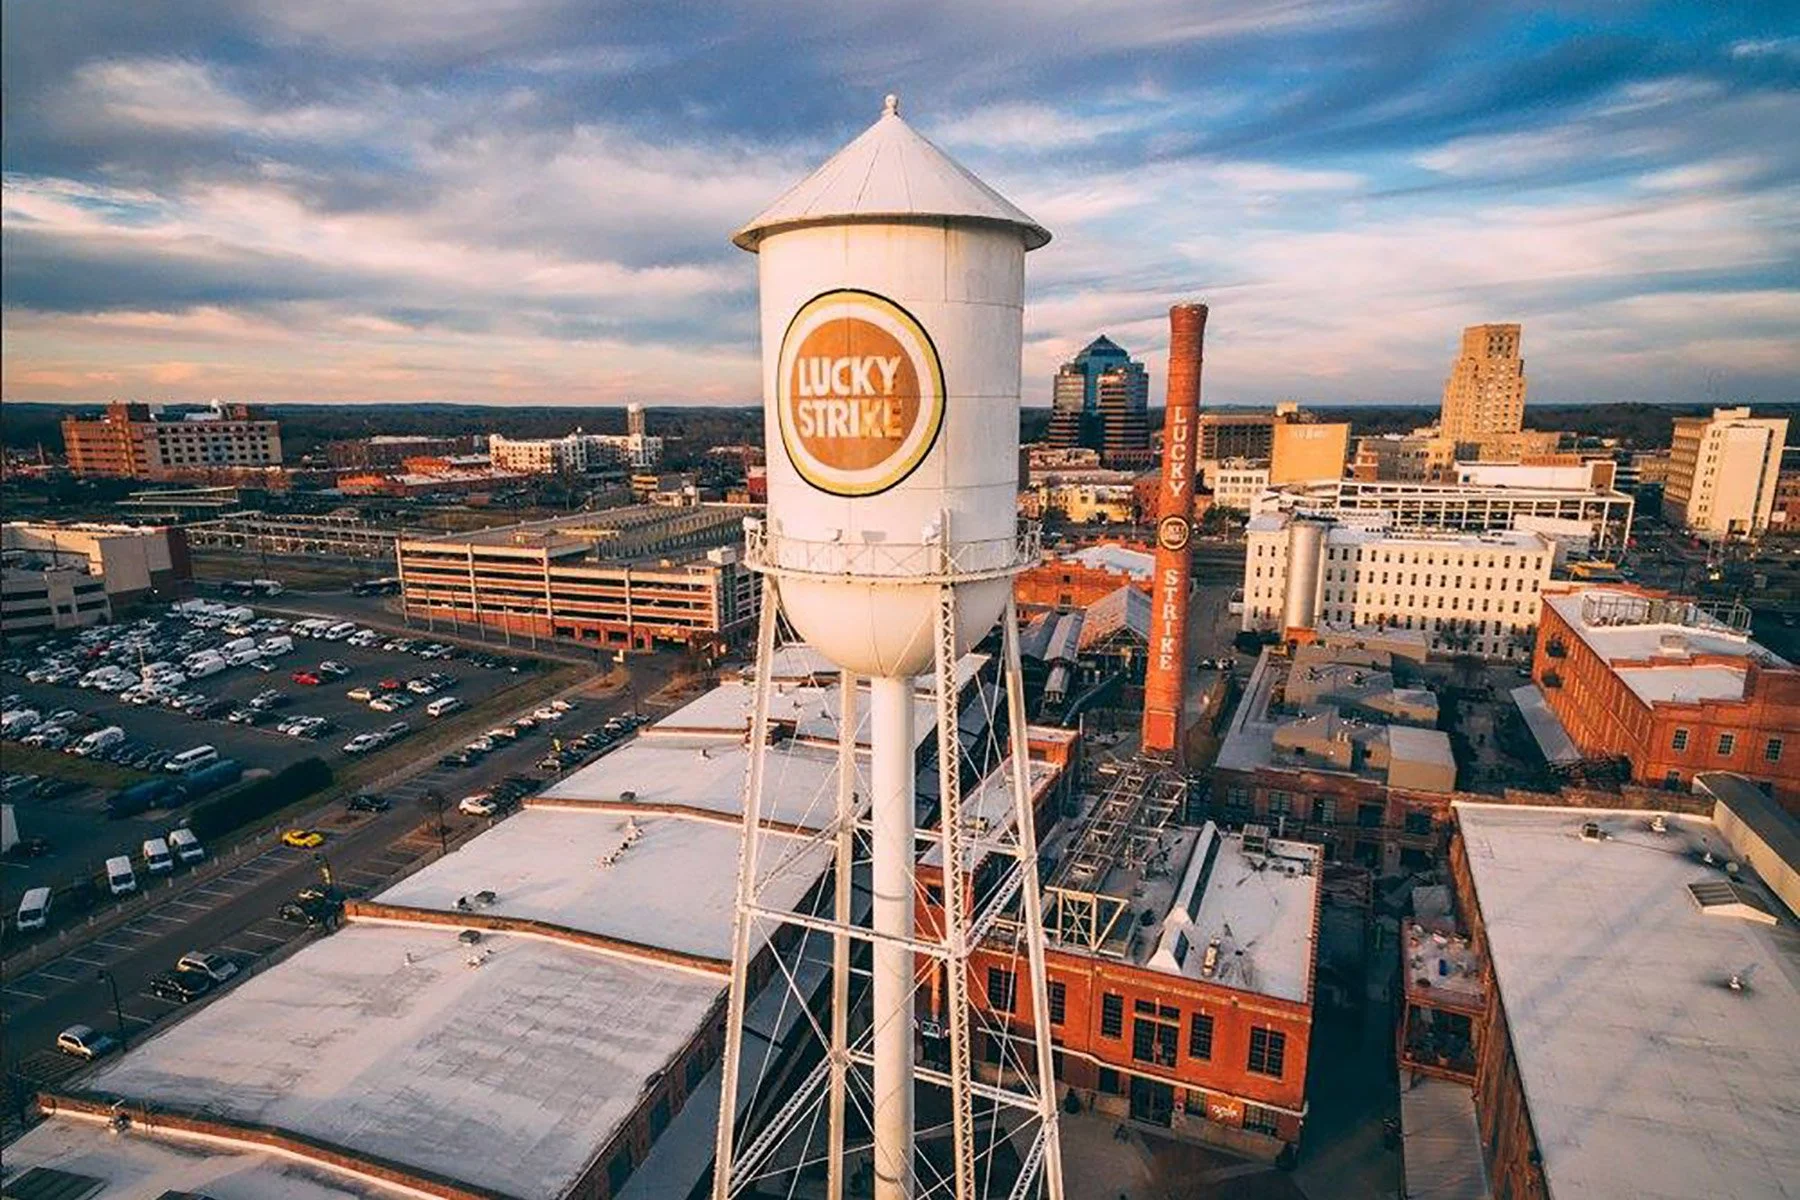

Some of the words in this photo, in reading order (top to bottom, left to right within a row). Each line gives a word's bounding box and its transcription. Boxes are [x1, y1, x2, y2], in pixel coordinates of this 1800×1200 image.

[799, 356, 902, 397] LUCKY
[799, 398, 903, 439] STRIKE
[1169, 406, 1188, 497] LUCKY
[1159, 568, 1179, 671] STRIKE
